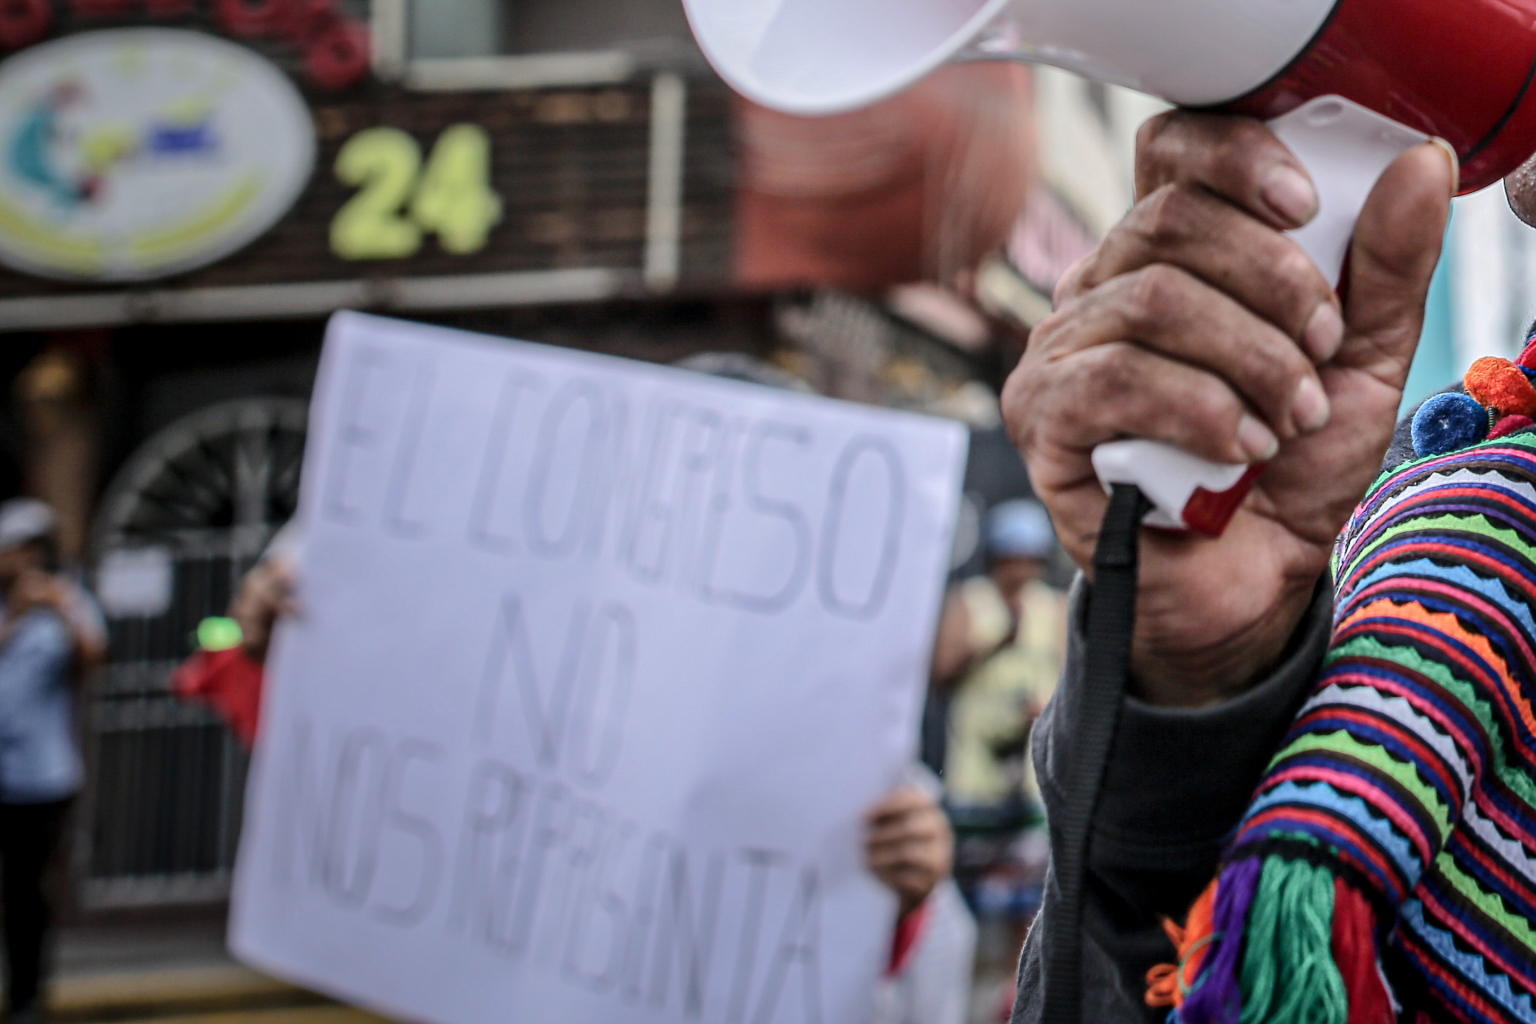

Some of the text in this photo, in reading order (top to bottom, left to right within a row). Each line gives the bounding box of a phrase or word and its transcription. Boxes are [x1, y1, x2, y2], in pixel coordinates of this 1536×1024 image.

[328, 122, 503, 261] 24
[321, 346, 438, 540] EL
[472, 588, 640, 790] NO
[271, 716, 448, 930] NOS
